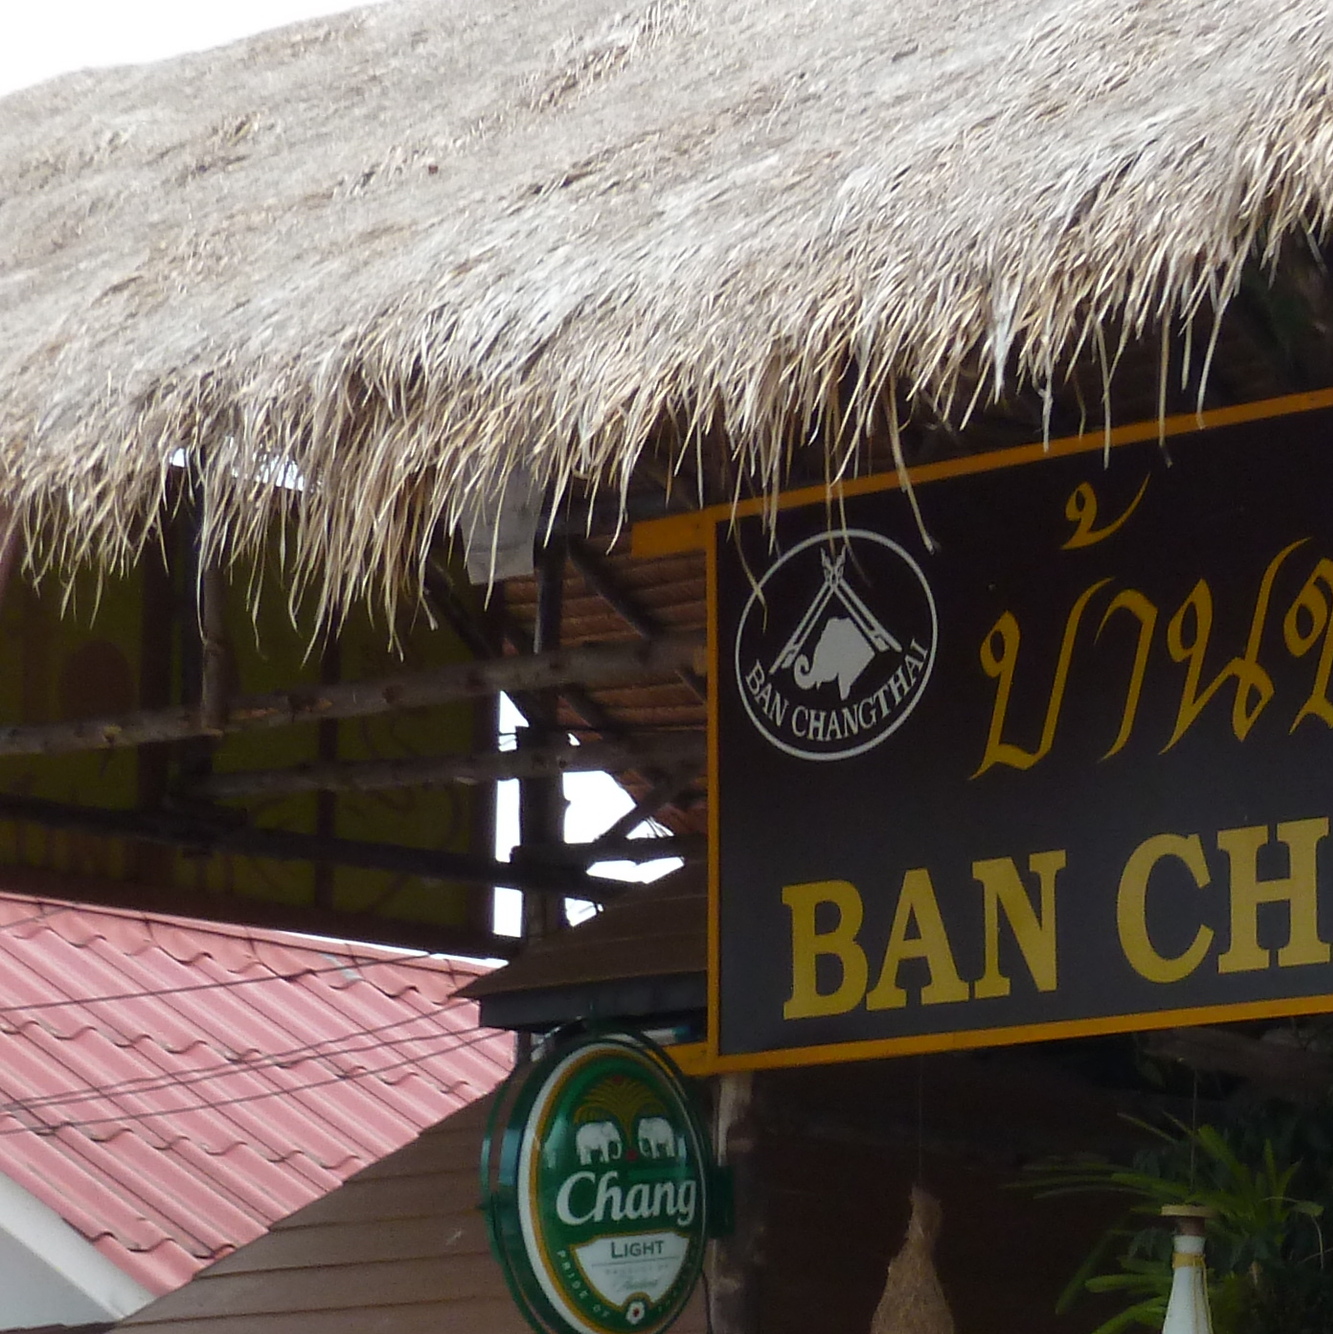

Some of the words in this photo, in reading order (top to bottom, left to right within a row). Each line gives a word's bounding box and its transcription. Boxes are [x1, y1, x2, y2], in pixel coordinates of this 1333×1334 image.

[745, 658, 790, 728] BAN
[792, 638, 929, 742] CHANGTHAI
[781, 848, 1067, 1019] BAN
[556, 1170, 696, 1226] Chang
[611, 1240, 664, 1260] LIGHT
